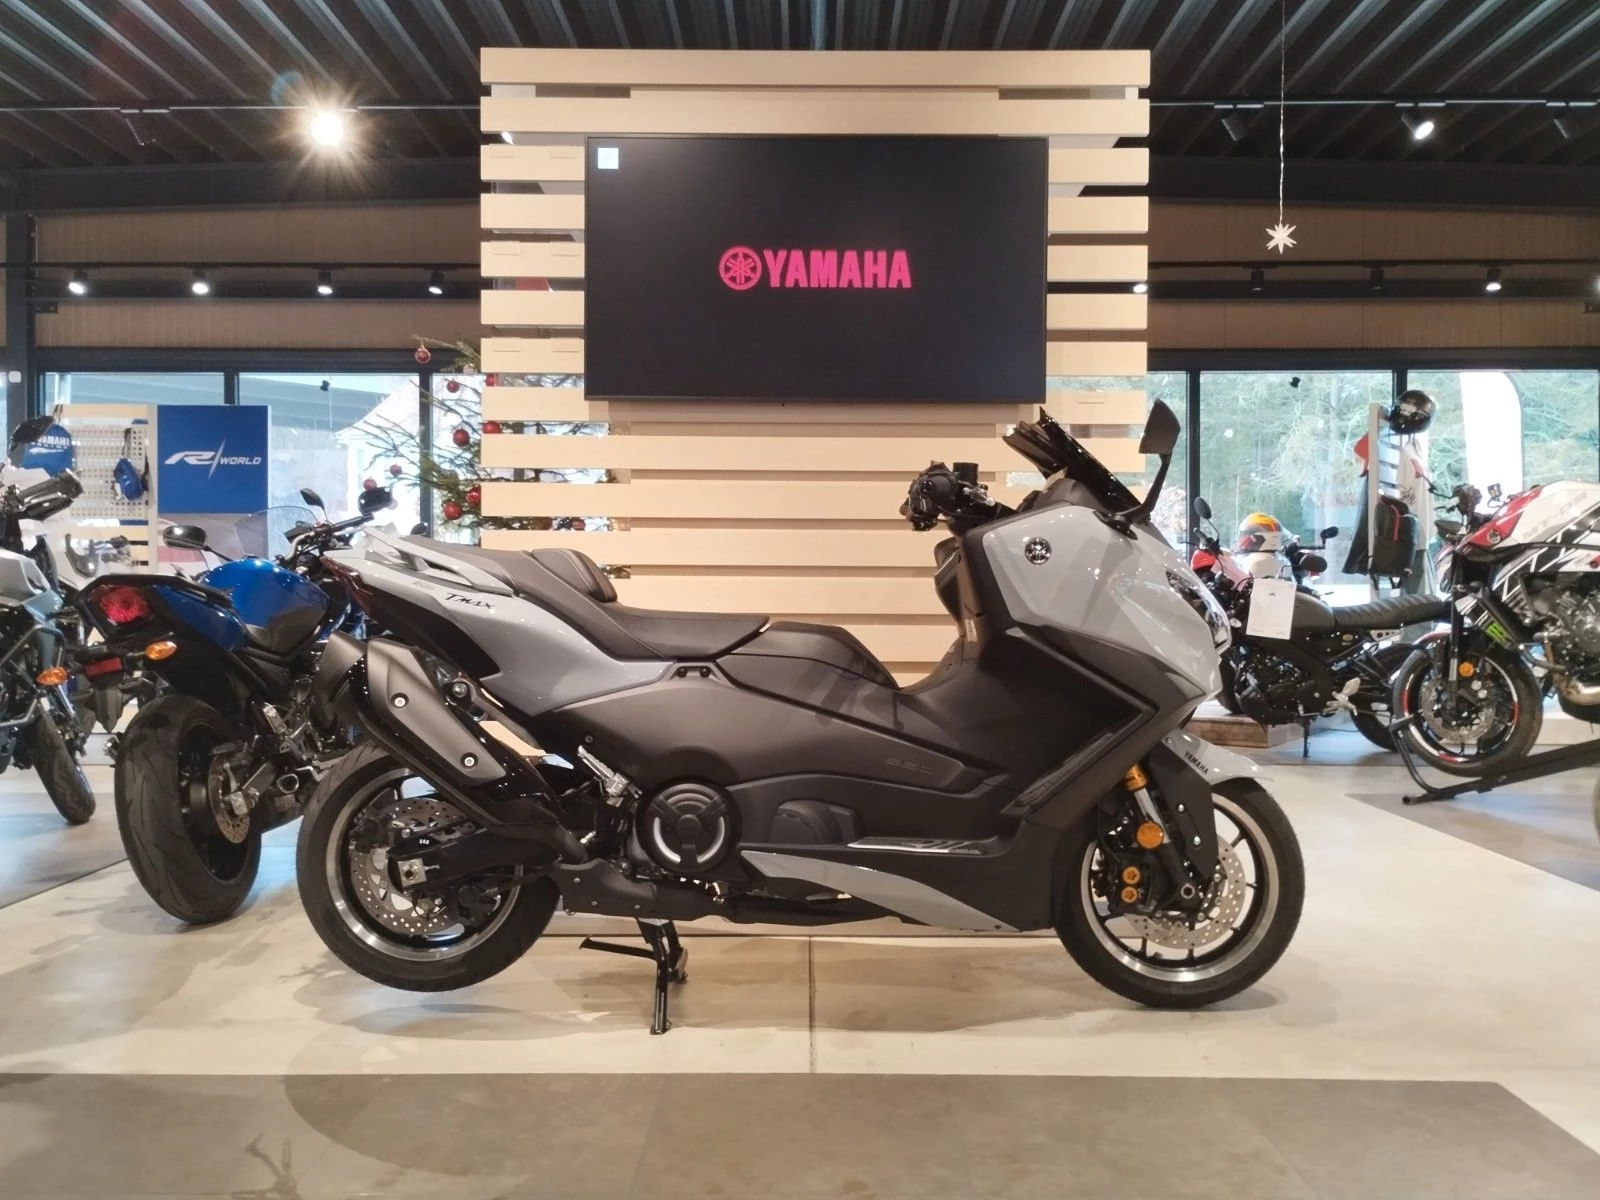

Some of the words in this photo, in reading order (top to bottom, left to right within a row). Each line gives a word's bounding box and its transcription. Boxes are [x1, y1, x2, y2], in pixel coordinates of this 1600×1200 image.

[763, 250, 912, 288] YAMAHA
[220, 456, 262, 465] WORLD
[1183, 750, 1209, 774] YAMAHA
